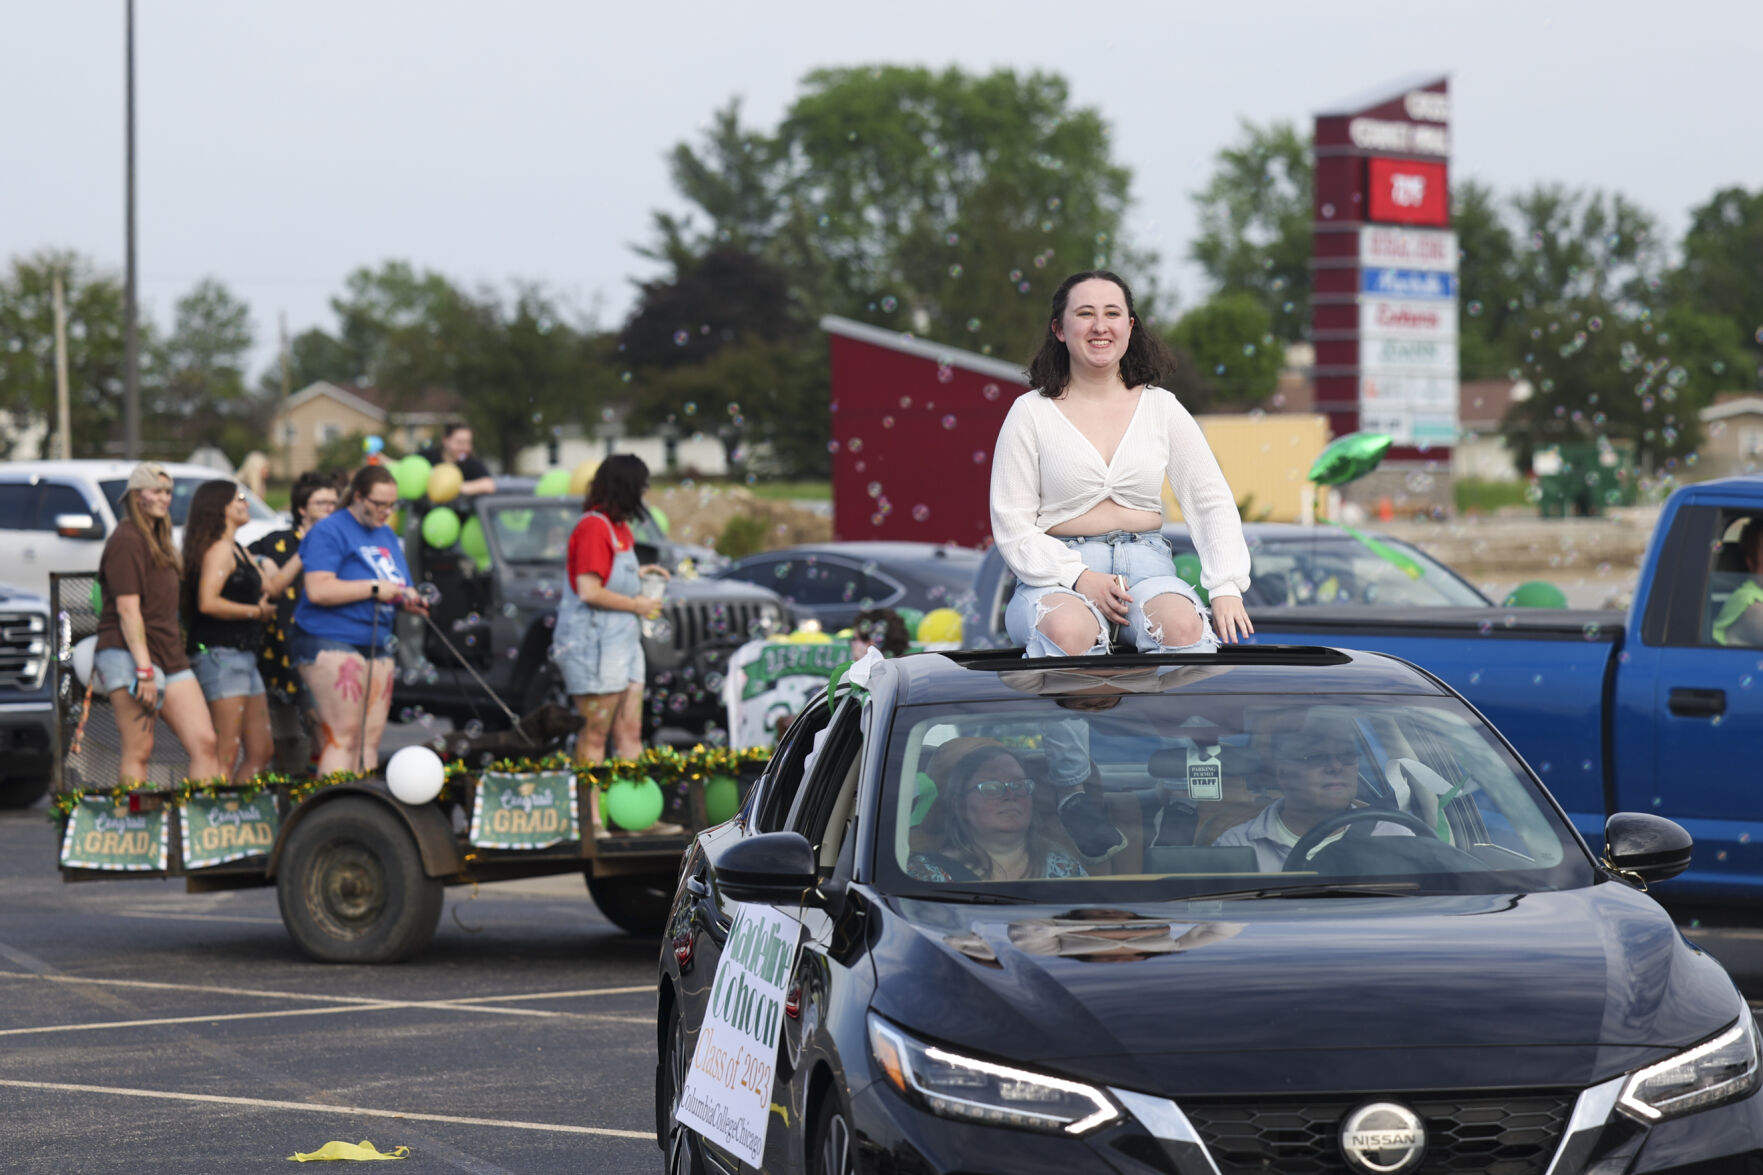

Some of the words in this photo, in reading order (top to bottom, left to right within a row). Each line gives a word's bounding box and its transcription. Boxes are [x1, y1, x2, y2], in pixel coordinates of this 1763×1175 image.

[1191, 778, 1217, 786] STAFF
[493, 808, 558, 833] GRAD
[85, 831, 150, 855] GRAD
[202, 823, 272, 850] GRAD
[712, 960, 779, 1049] Cohoon
[695, 1027, 728, 1081] Class
[725, 1045, 744, 1090] of
[741, 1053, 771, 1109] 2023
[1352, 1134, 1416, 1145] NISSAN
